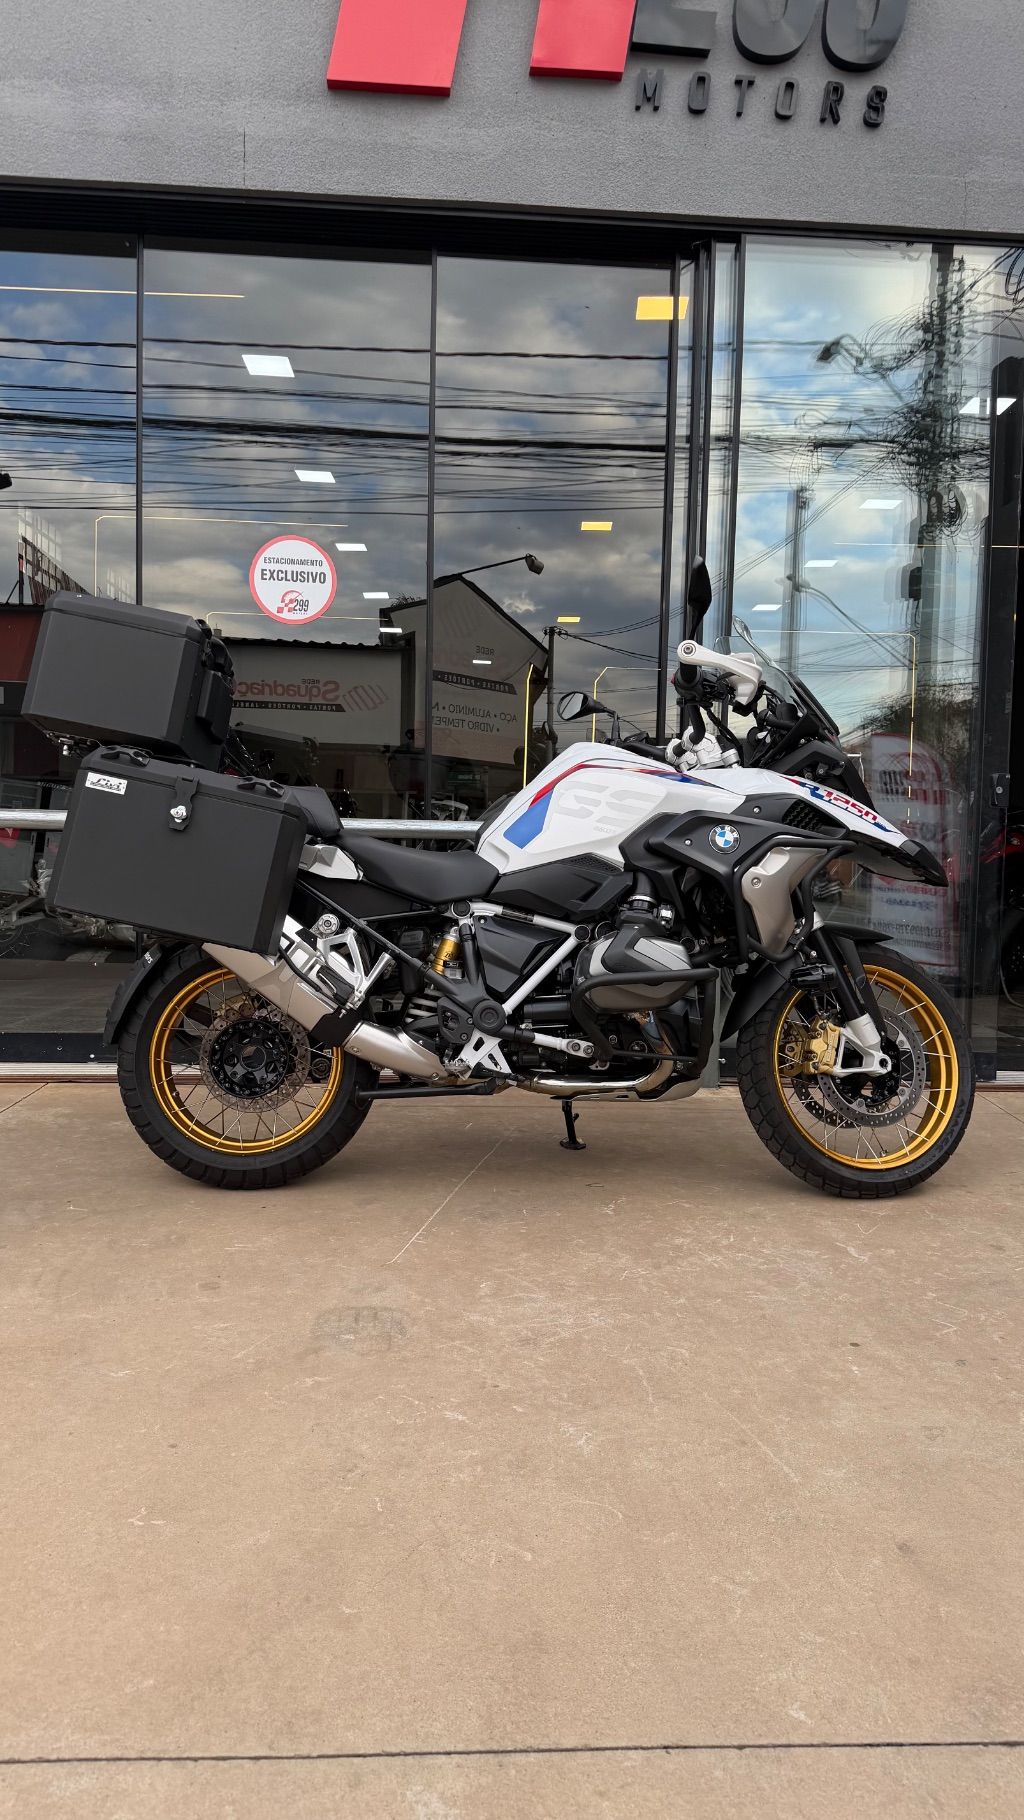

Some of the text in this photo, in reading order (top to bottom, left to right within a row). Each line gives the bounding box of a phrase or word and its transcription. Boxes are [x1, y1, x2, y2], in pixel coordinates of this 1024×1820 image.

[635, 68, 889, 128] MOTORS
[263, 556, 323, 567] ESTACIONAMENTO
[260, 568, 327, 585] EXCLUSIVO
[292, 599, 310, 612] 299
